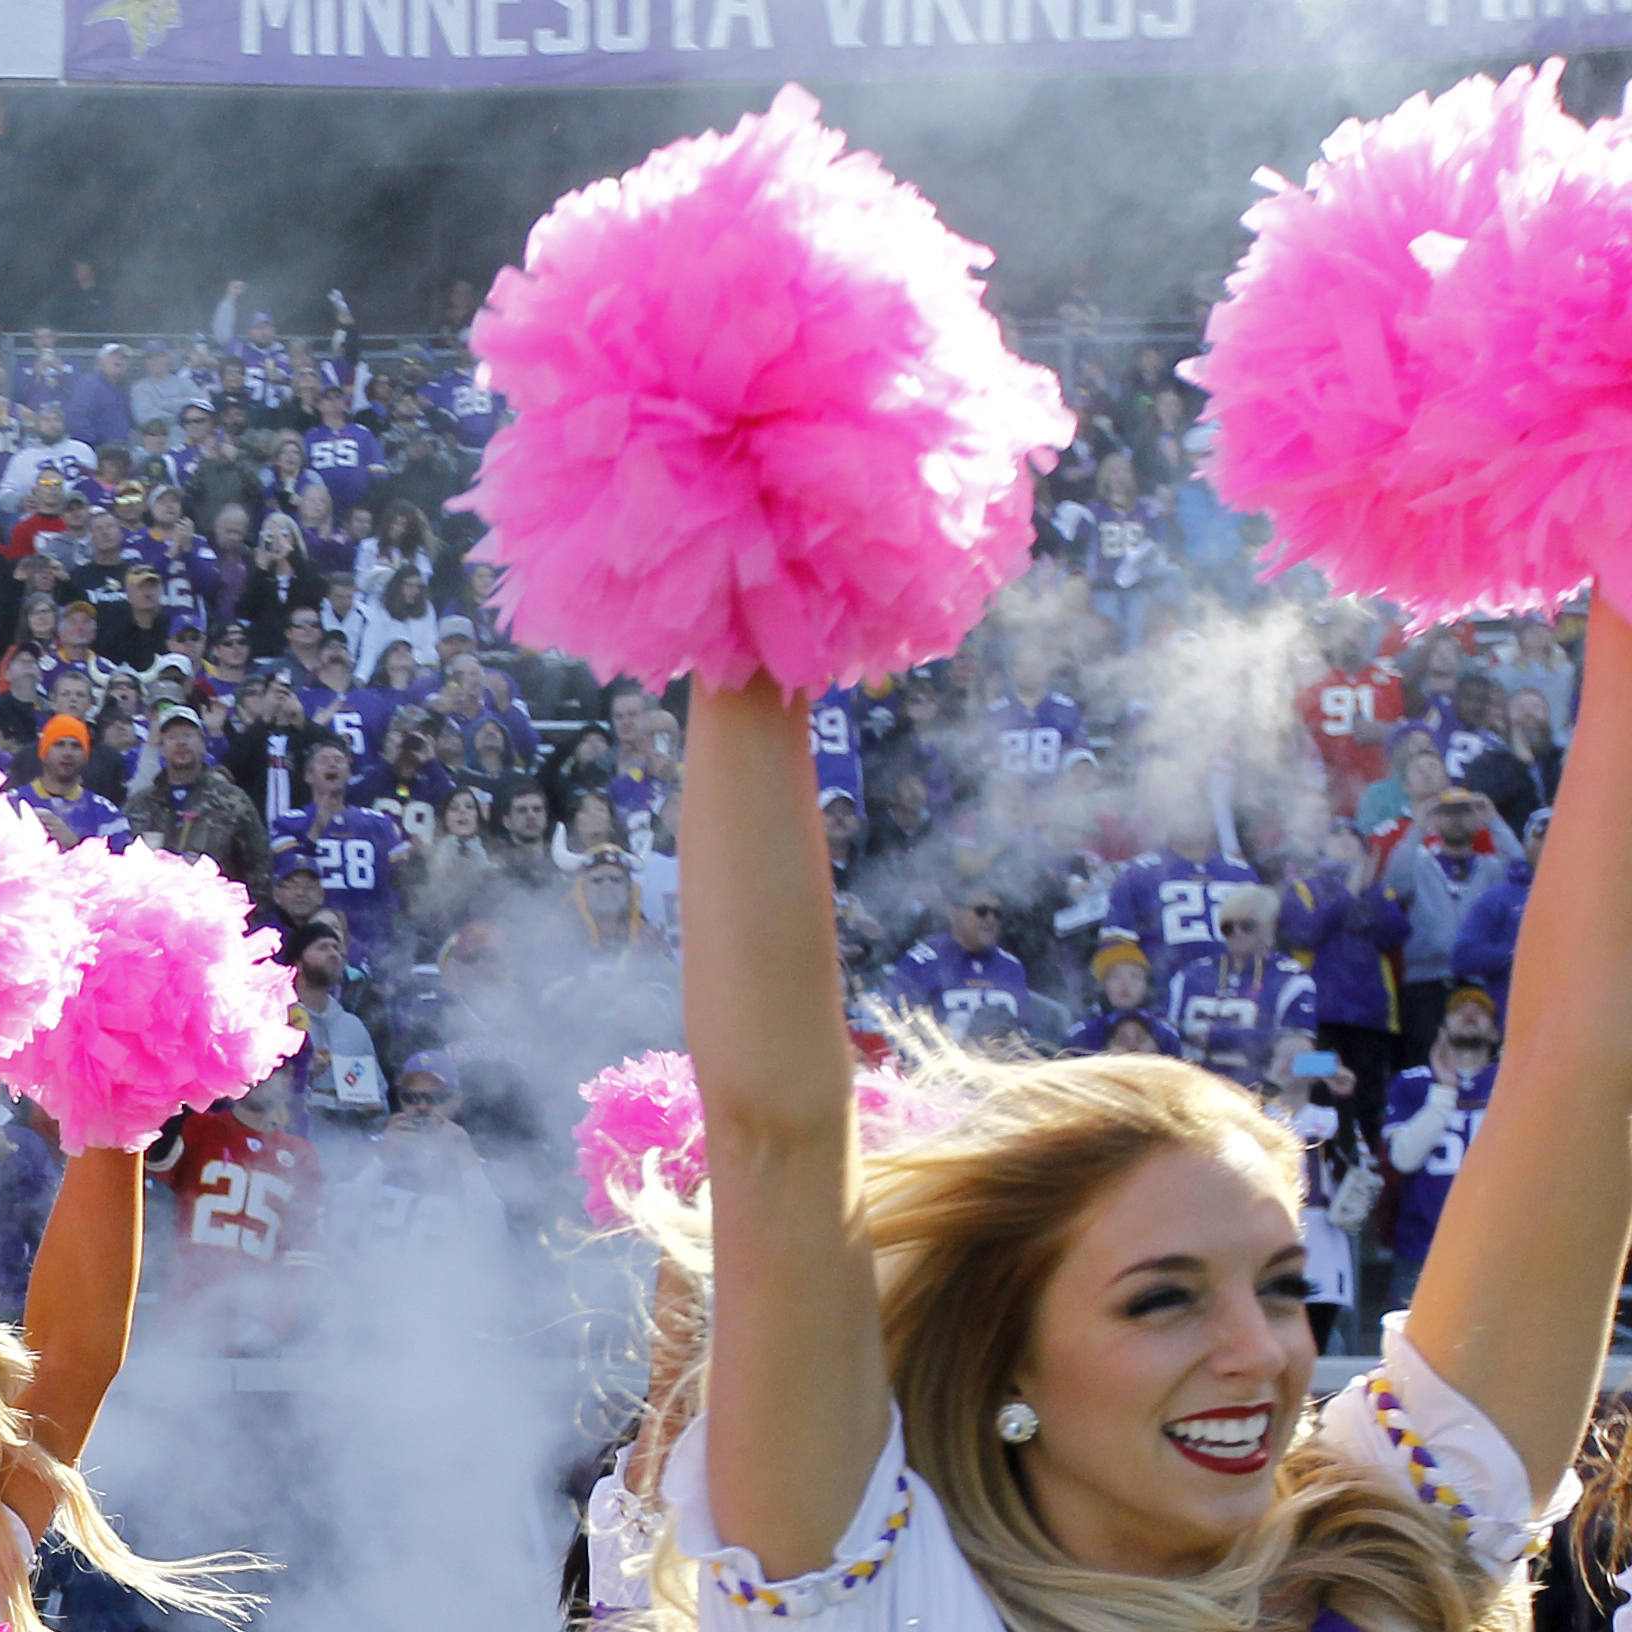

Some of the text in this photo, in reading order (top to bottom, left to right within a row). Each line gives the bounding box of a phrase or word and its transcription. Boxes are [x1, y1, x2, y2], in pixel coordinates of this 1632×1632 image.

[310, 438, 360, 469] 55
[1320, 685, 1375, 736] 91
[999, 728, 1063, 773] 28
[315, 838, 376, 891] 28
[190, 1158, 293, 1262] 25
